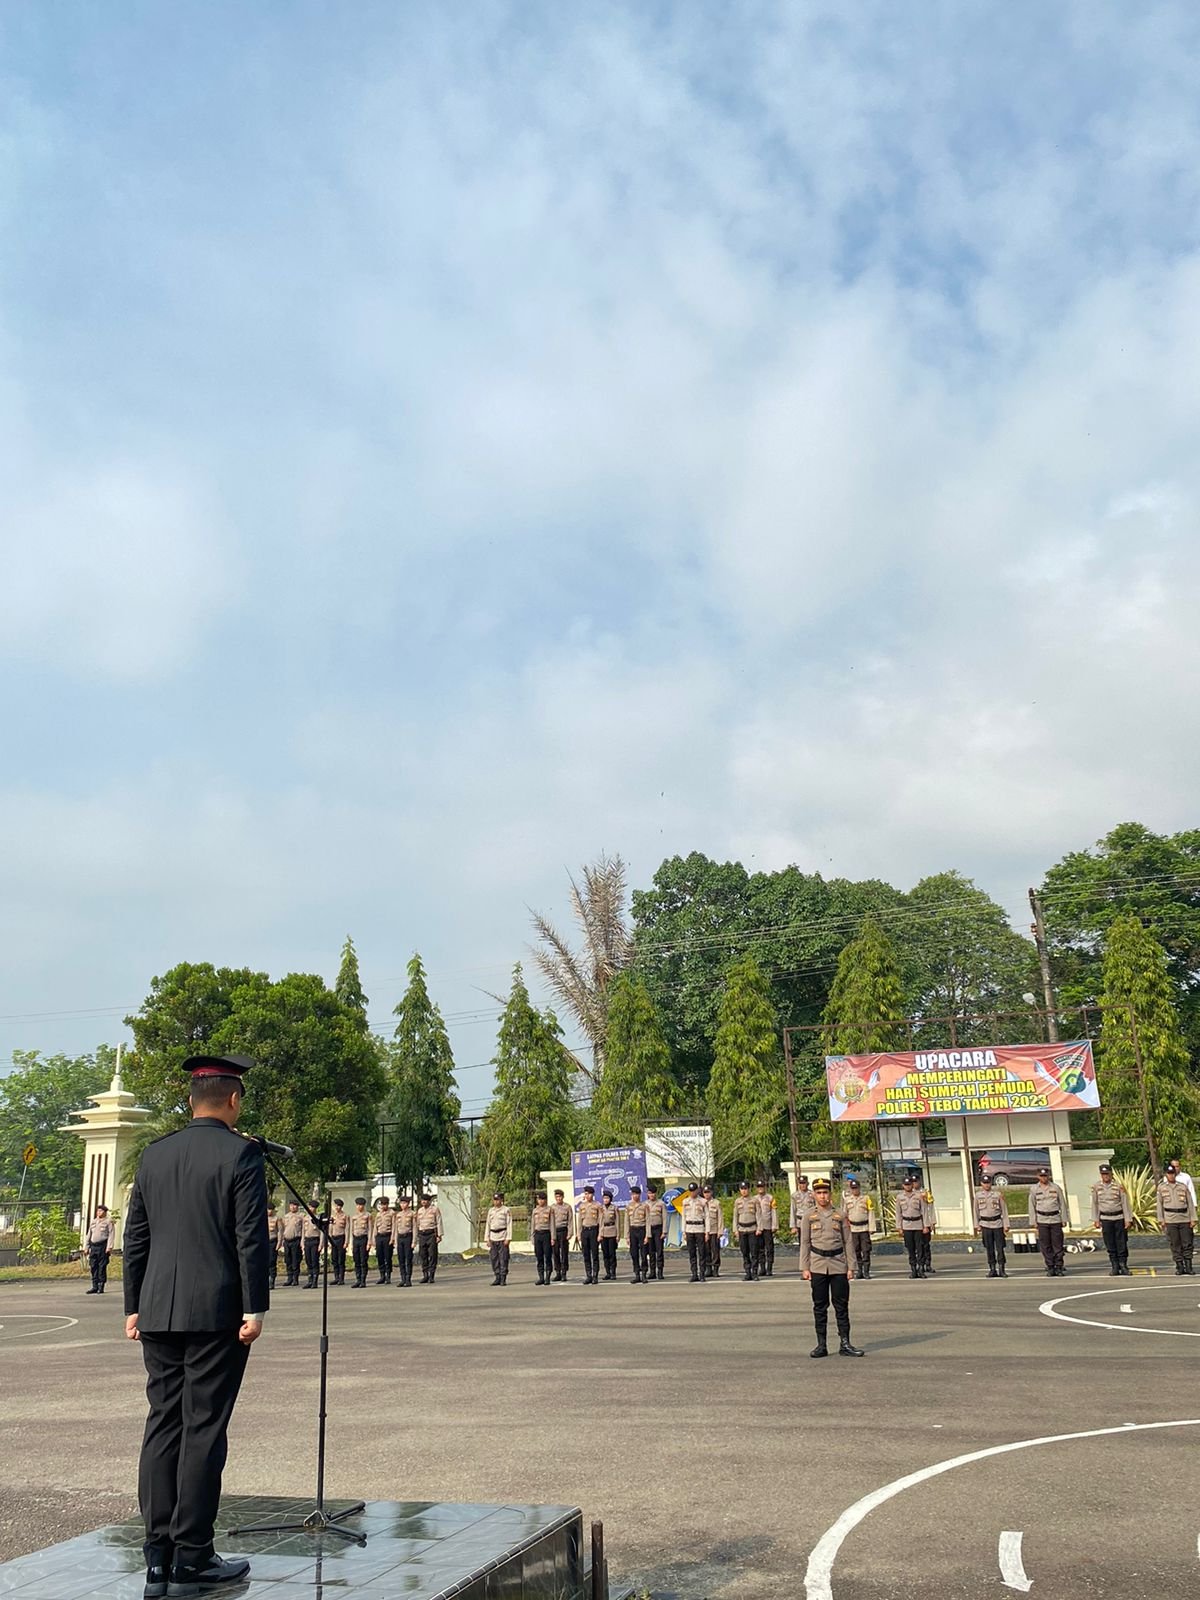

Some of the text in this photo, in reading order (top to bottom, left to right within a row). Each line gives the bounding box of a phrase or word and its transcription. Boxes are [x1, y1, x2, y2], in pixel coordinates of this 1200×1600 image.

[915, 1051, 996, 1069] UPACARA
[907, 1068, 1007, 1085] MEMPERINGATI
[886, 1080, 1035, 1100] HARI SUMPAH PEMUDA
[877, 1095, 1048, 1115] POLRES TEBO TAHUN 2023
